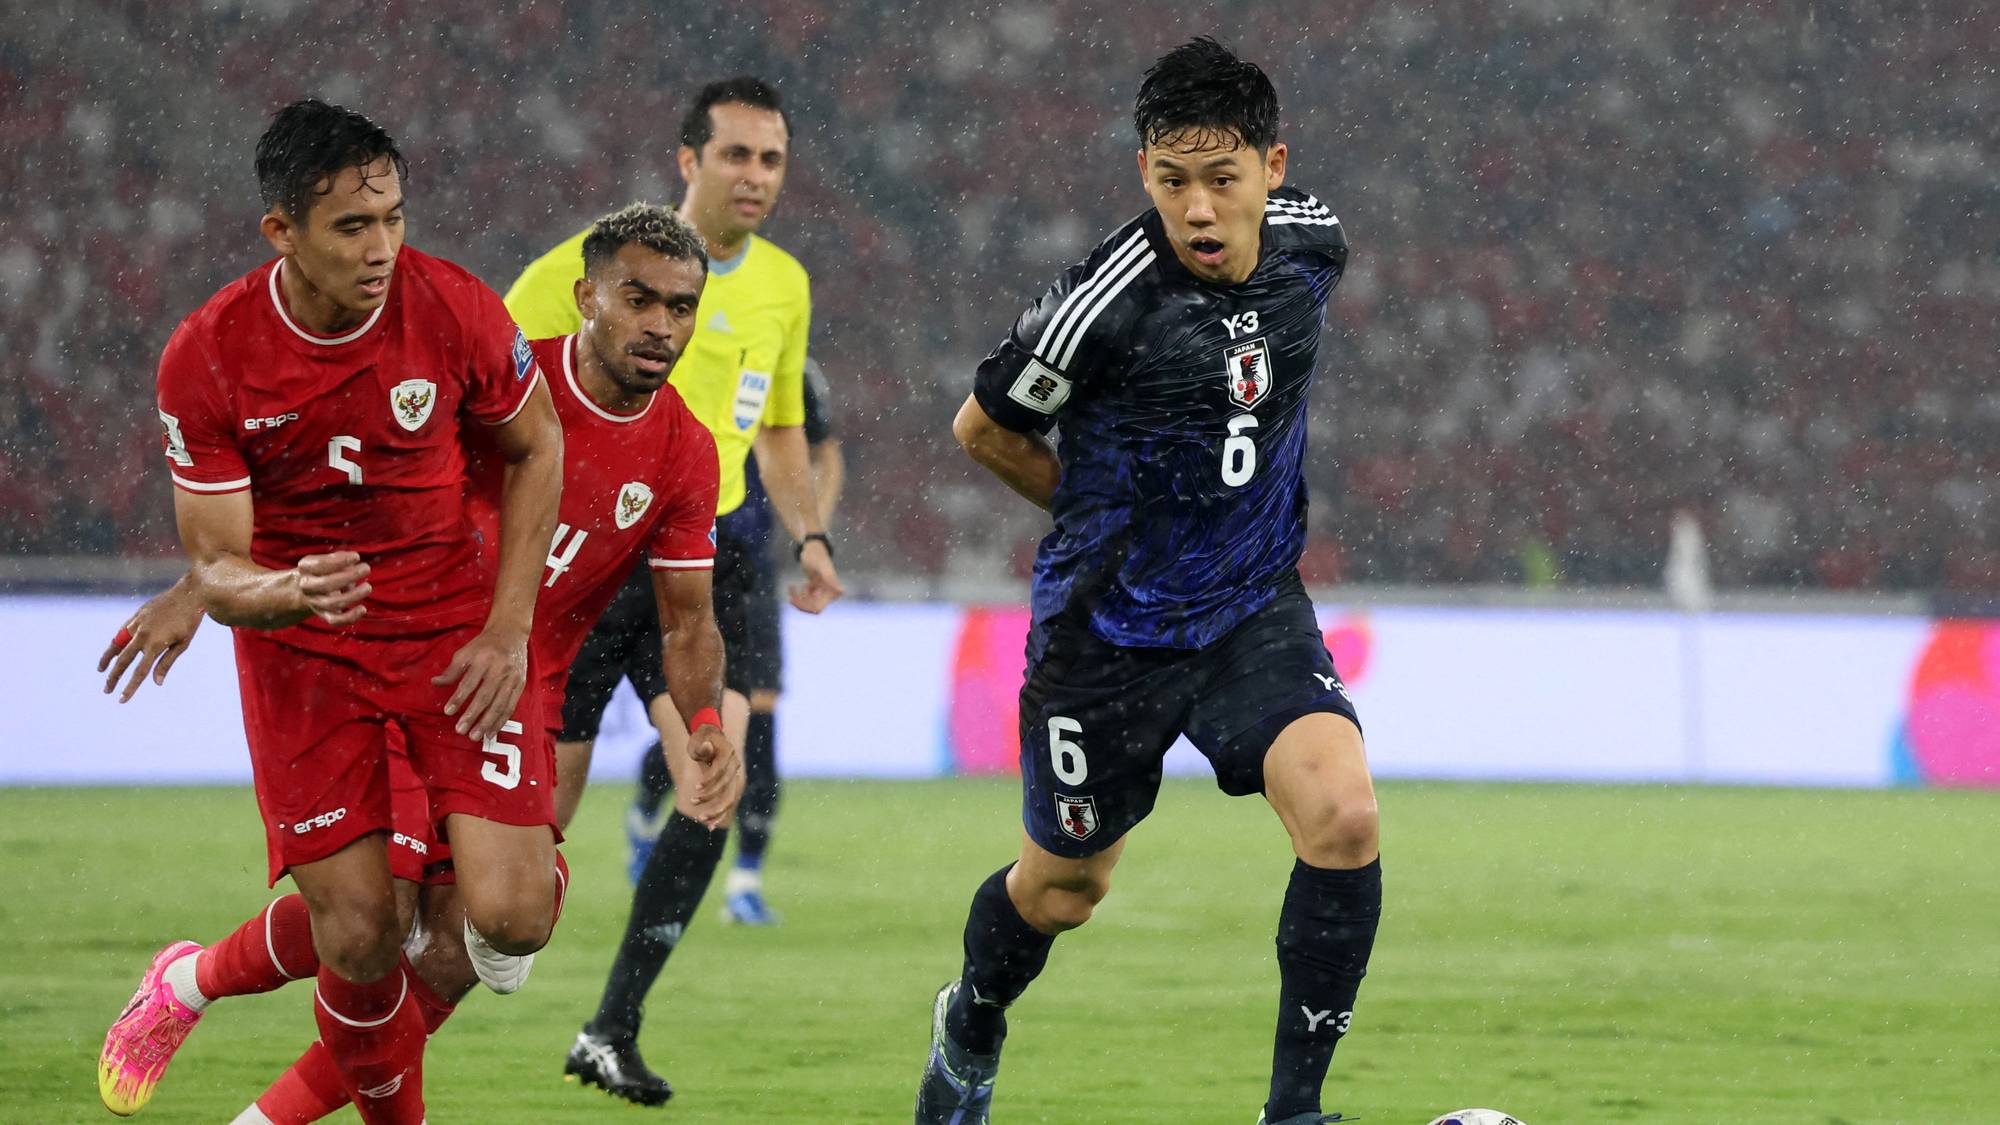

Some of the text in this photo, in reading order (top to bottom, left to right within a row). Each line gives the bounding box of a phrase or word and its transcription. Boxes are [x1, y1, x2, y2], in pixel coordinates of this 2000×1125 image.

[1221, 310, 1259, 340] Y-3
[1234, 342, 1256, 355] JAPAN
[741, 372, 767, 392] FIFA
[244, 412, 299, 430] erspo
[1221, 414, 1259, 487] 6
[480, 720, 523, 790] 5
[1048, 715, 1089, 786] 6
[293, 807, 347, 834] erspo
[1300, 1005, 1353, 1033] Y-3
